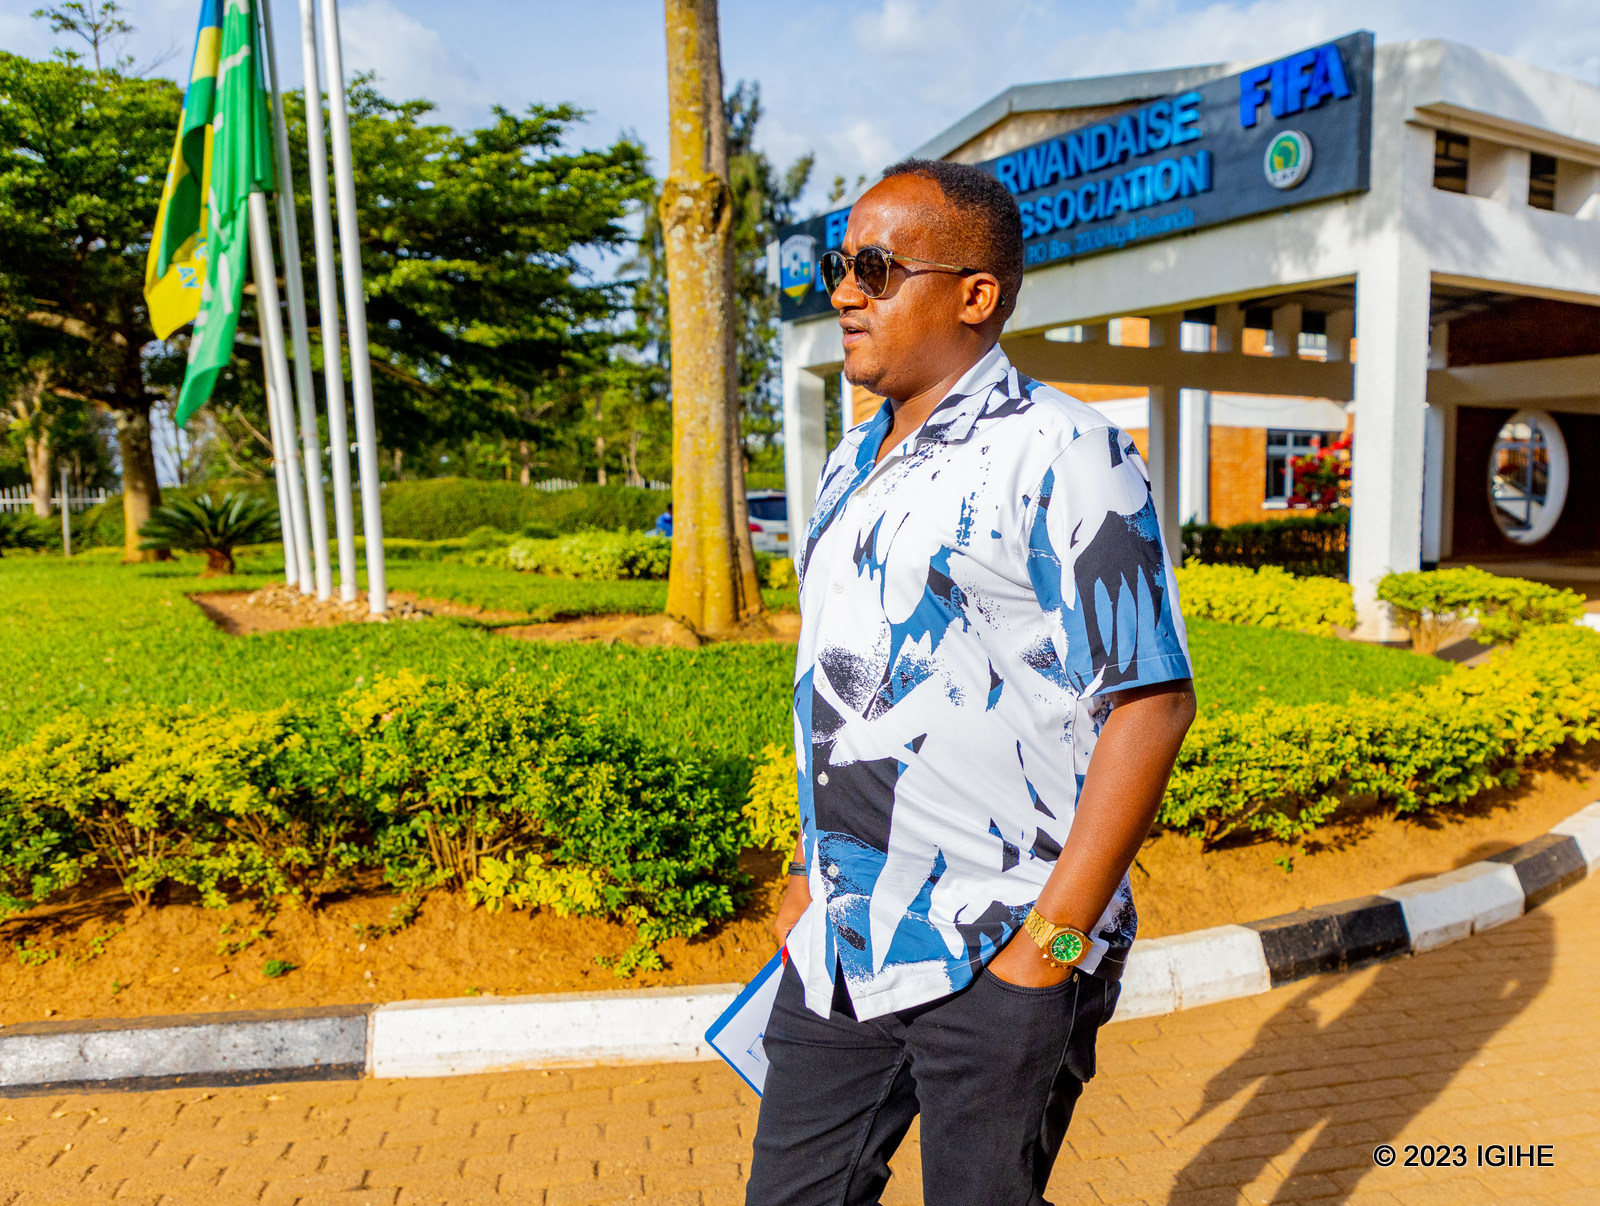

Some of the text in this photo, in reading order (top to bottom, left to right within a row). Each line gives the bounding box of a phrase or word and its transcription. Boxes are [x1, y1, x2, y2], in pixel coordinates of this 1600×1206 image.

[1240, 43, 1350, 128] FIFA
[996, 91, 1202, 194] RWANDAISE
[1018, 150, 1211, 240] SSOCIATION
